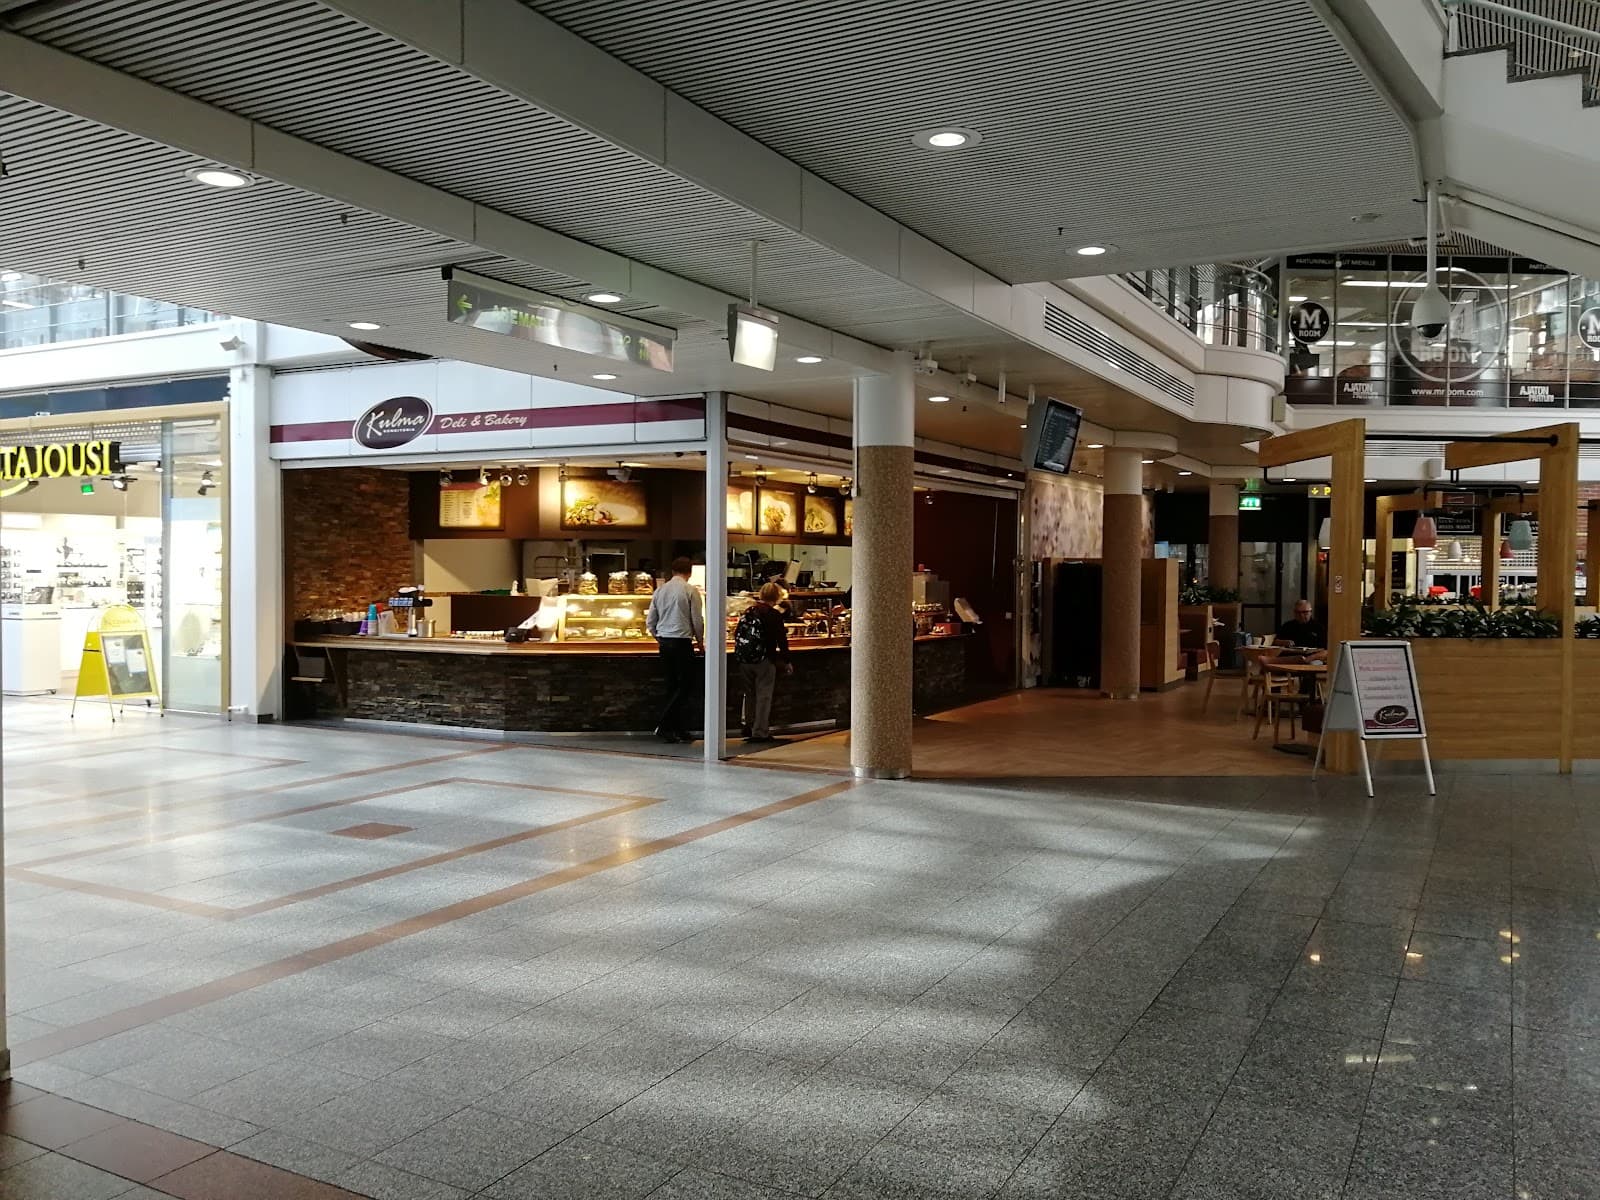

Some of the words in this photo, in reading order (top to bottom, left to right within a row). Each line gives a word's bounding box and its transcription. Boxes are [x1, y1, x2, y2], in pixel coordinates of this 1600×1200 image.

[1300, 309, 1321, 329] M
[1343, 383, 1373, 393] AJATON
[1519, 385, 1549, 395] AJATON
[366, 407, 425, 439] Kulma
[440, 416, 467, 429] Deli
[470, 414, 481, 426] &
[484, 413, 528, 427] Bakery
[0, 441, 112, 480] TAJOUSI
